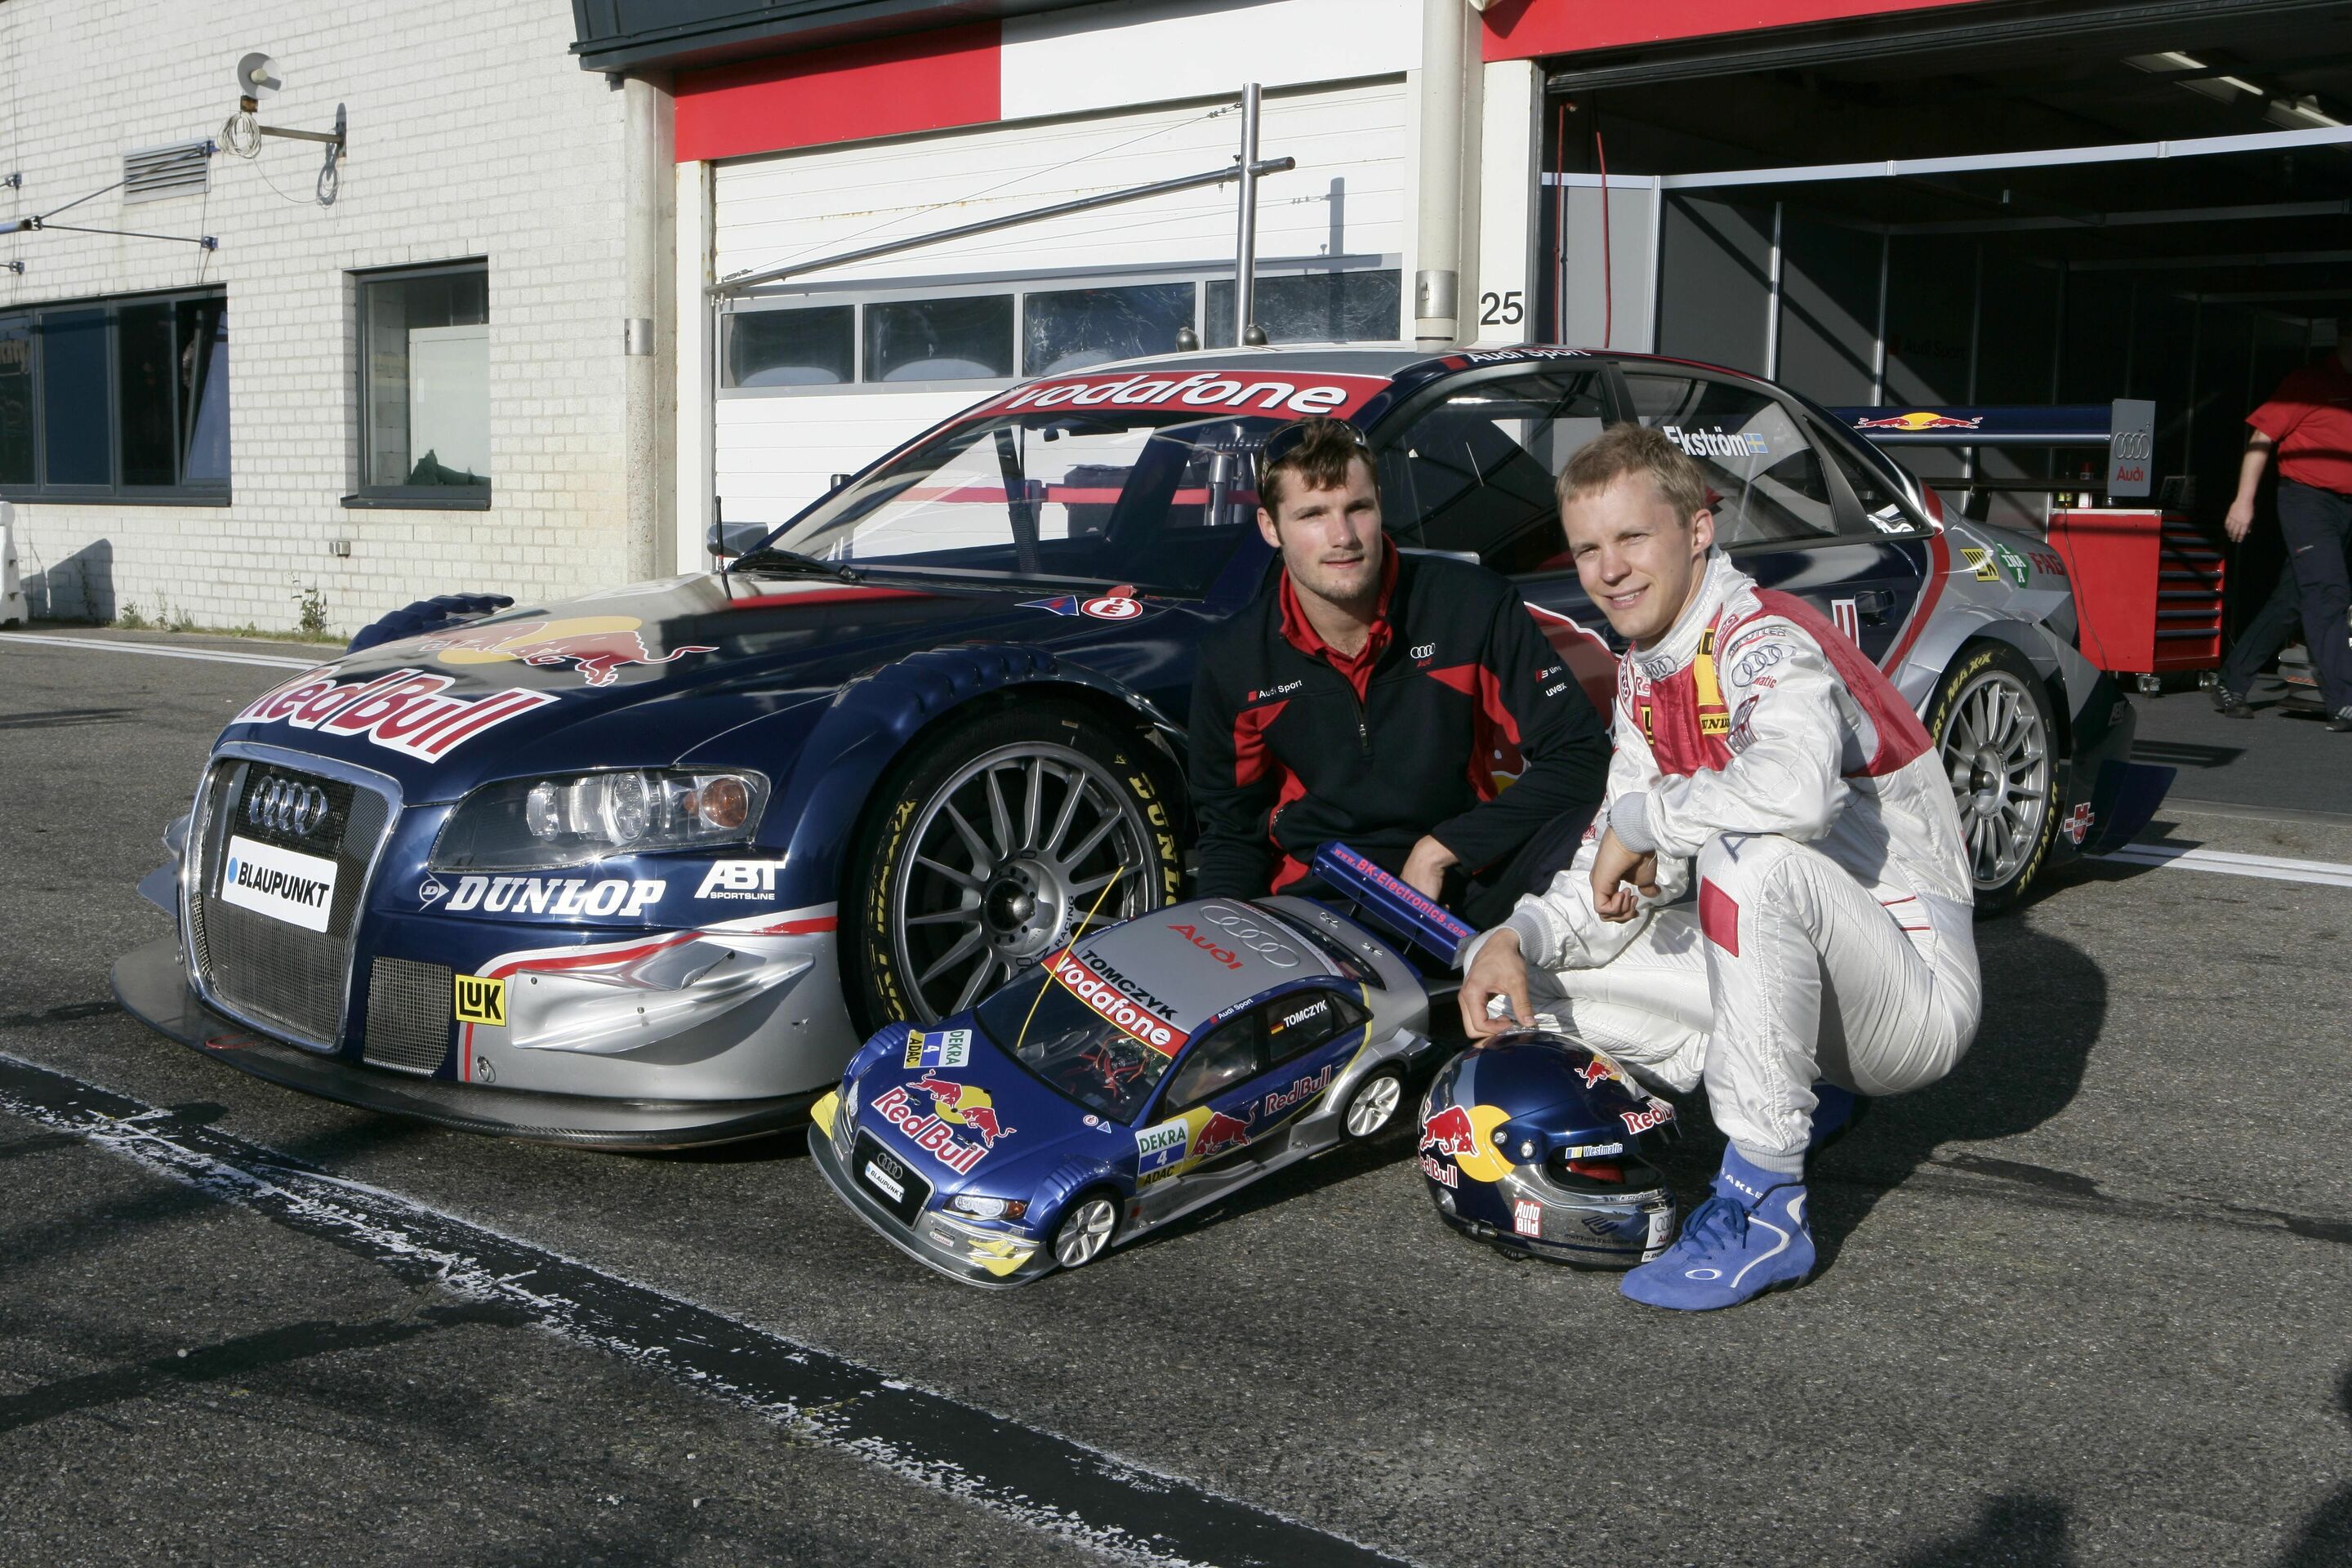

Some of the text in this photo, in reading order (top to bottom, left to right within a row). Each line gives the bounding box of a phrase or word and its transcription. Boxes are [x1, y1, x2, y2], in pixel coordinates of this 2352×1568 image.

[1480, 291, 1524, 326] 25
[1470, 347, 1592, 363] Audi Sport
[1006, 372, 1348, 414] vodafone
[1663, 426, 1750, 457] Ekström
[2116, 466, 2144, 482] Audi
[1258, 679, 1303, 699] Audi Sport
[1545, 681, 1567, 697] uvex
[238, 860, 330, 909] BLAUPUNKT
[693, 859, 786, 898] ABT
[444, 875, 666, 917] DUNLOP
[710, 891, 776, 901] SPORTSLINE
[1334, 847, 1468, 938] www.BK-Electronics.com
[1054, 895, 1076, 948] RACING
[1166, 924, 1244, 971] Audi
[1082, 949, 1178, 1020] TOMCZYK
[1057, 956, 1172, 1046] vodafone
[1217, 997, 1254, 1020] Audi Sport
[1283, 1000, 1328, 1029] TOMCZYK
[906, 1037, 922, 1064] ADAC
[923, 1044, 940, 1054] 4
[946, 1030, 964, 1066] DEKRA
[1139, 1126, 1187, 1153] DEKRA
[1584, 1143, 1624, 1157] Westmatic
[1156, 1149, 1167, 1166] 4
[871, 1170, 903, 1199] BLAUPUNKT
[1143, 1165, 1175, 1186] ADAC
[1515, 1201, 1541, 1221] Auto
[934, 1235, 951, 1245] Castrol
[1516, 1217, 1539, 1236] Bild
